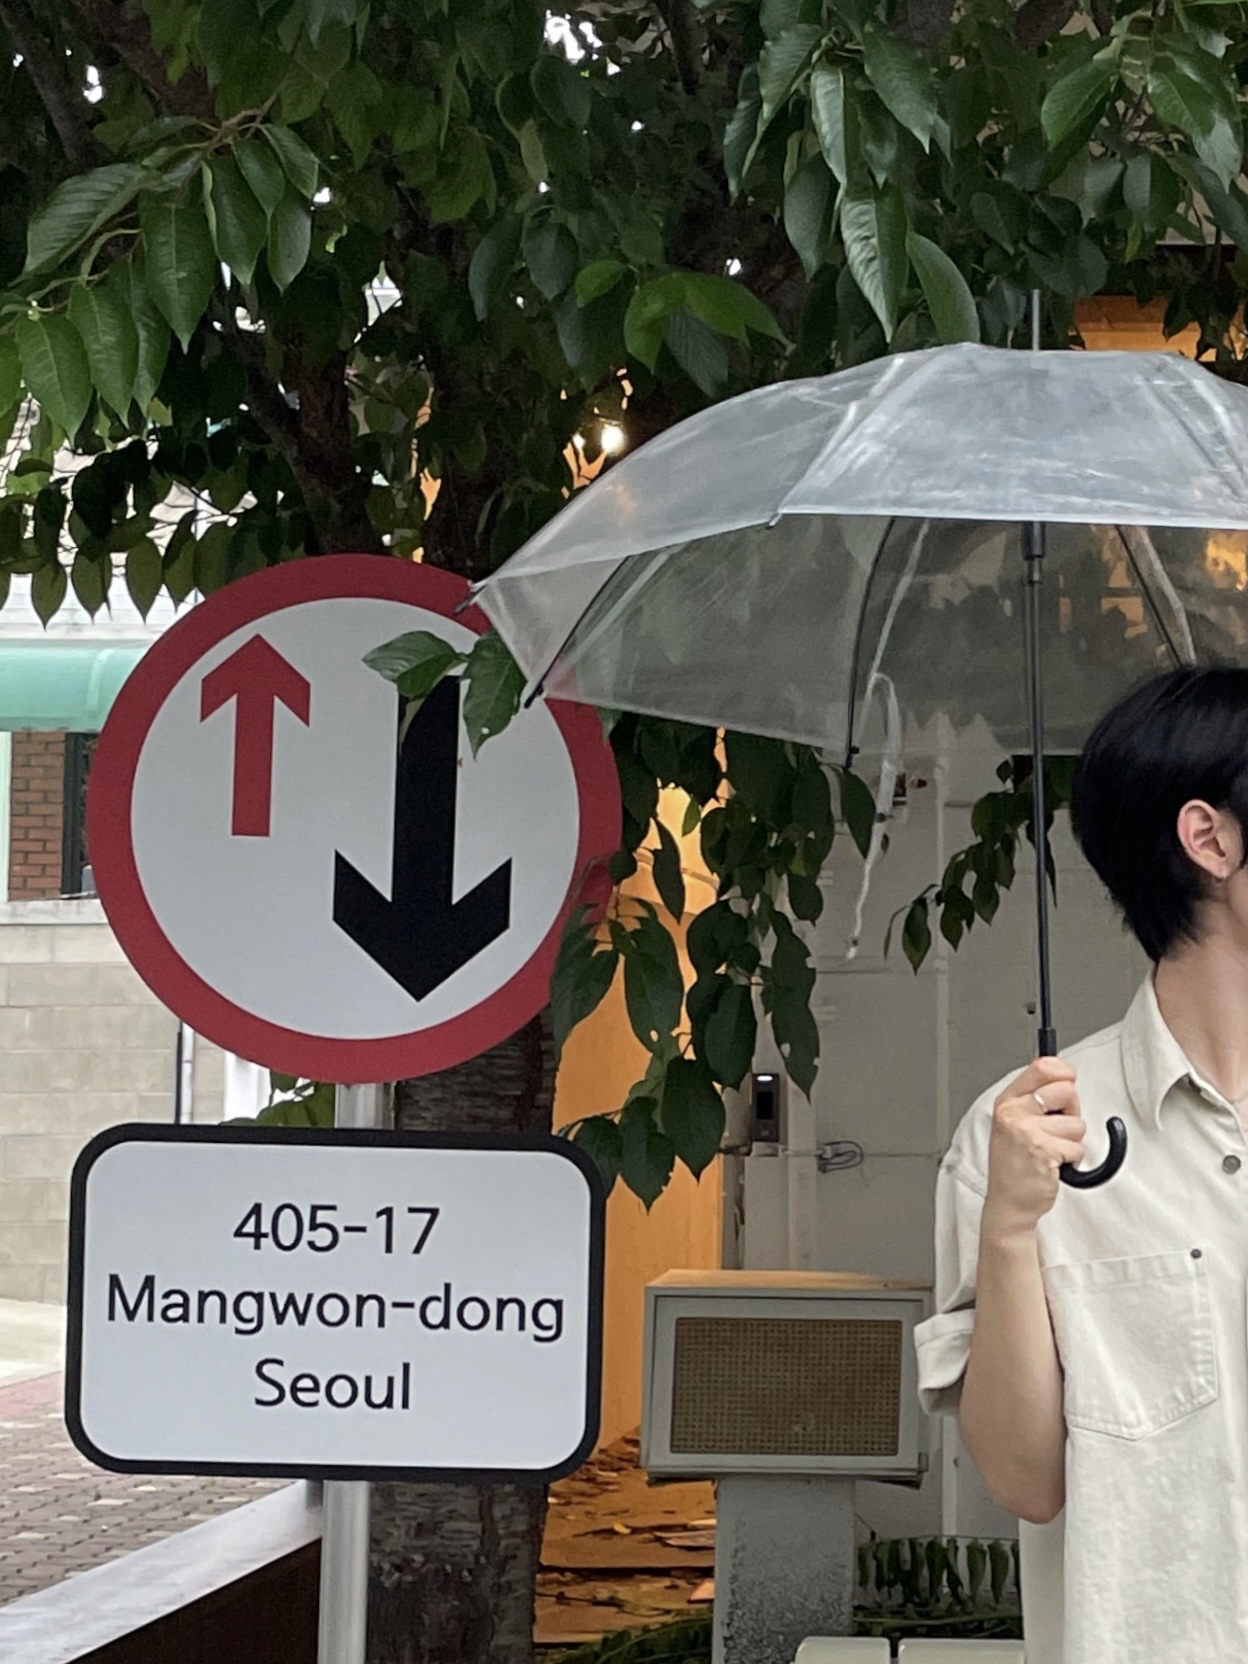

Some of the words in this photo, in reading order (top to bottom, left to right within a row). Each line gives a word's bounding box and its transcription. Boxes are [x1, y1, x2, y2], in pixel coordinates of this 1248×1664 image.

[232, 1202, 441, 1255] 405-17
[107, 1273, 565, 1343] Mangwon-dong
[254, 1357, 411, 1410] Seoul
